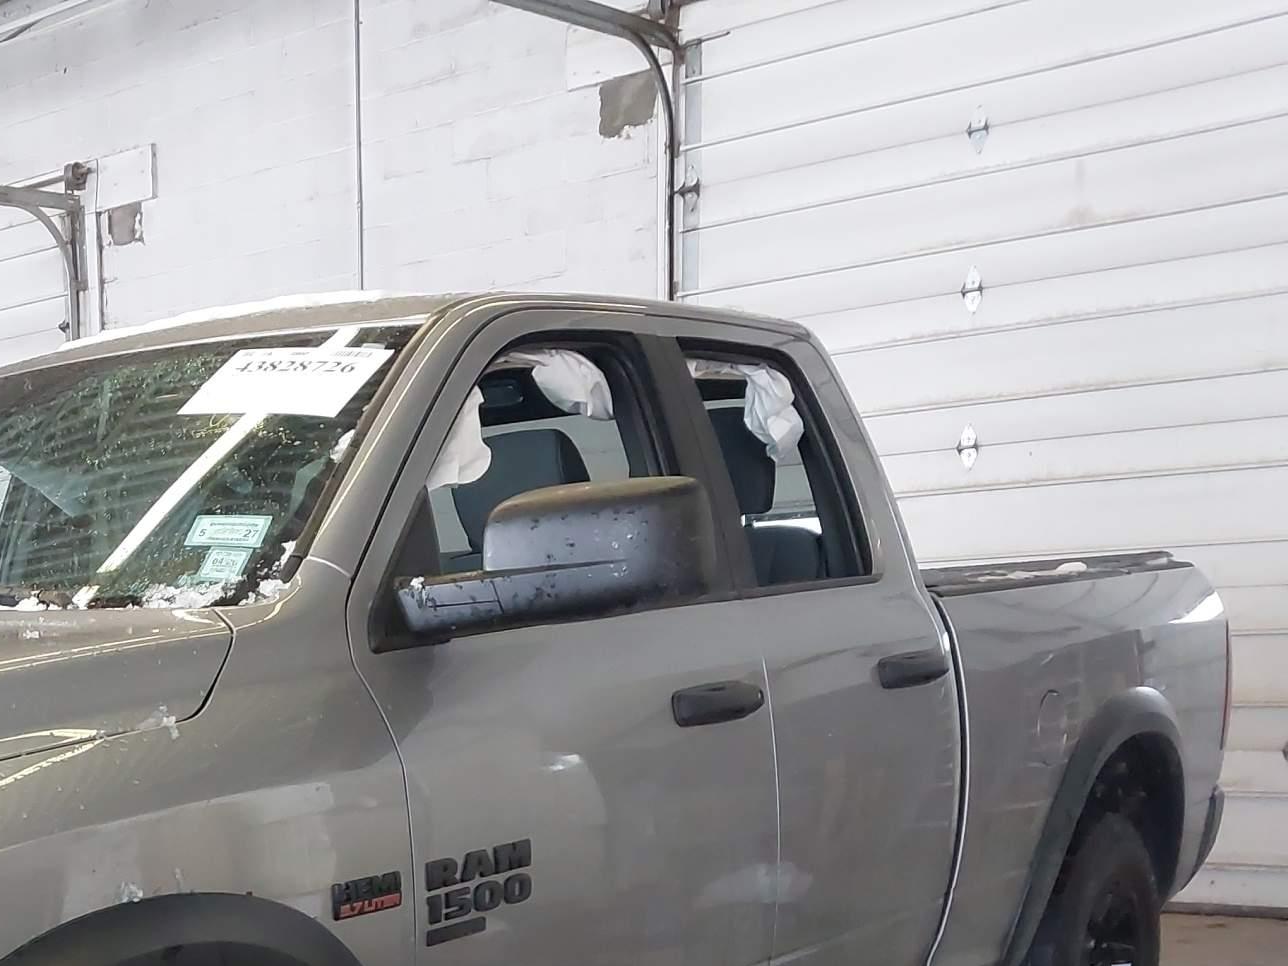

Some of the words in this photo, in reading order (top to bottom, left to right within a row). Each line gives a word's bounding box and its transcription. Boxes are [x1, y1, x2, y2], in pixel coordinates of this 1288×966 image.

[235, 360, 358, 373] 43828726
[198, 528, 208, 537] 5
[242, 528, 260, 538] 27
[424, 838, 532, 893] RAM
[426, 872, 532, 925] 1500
